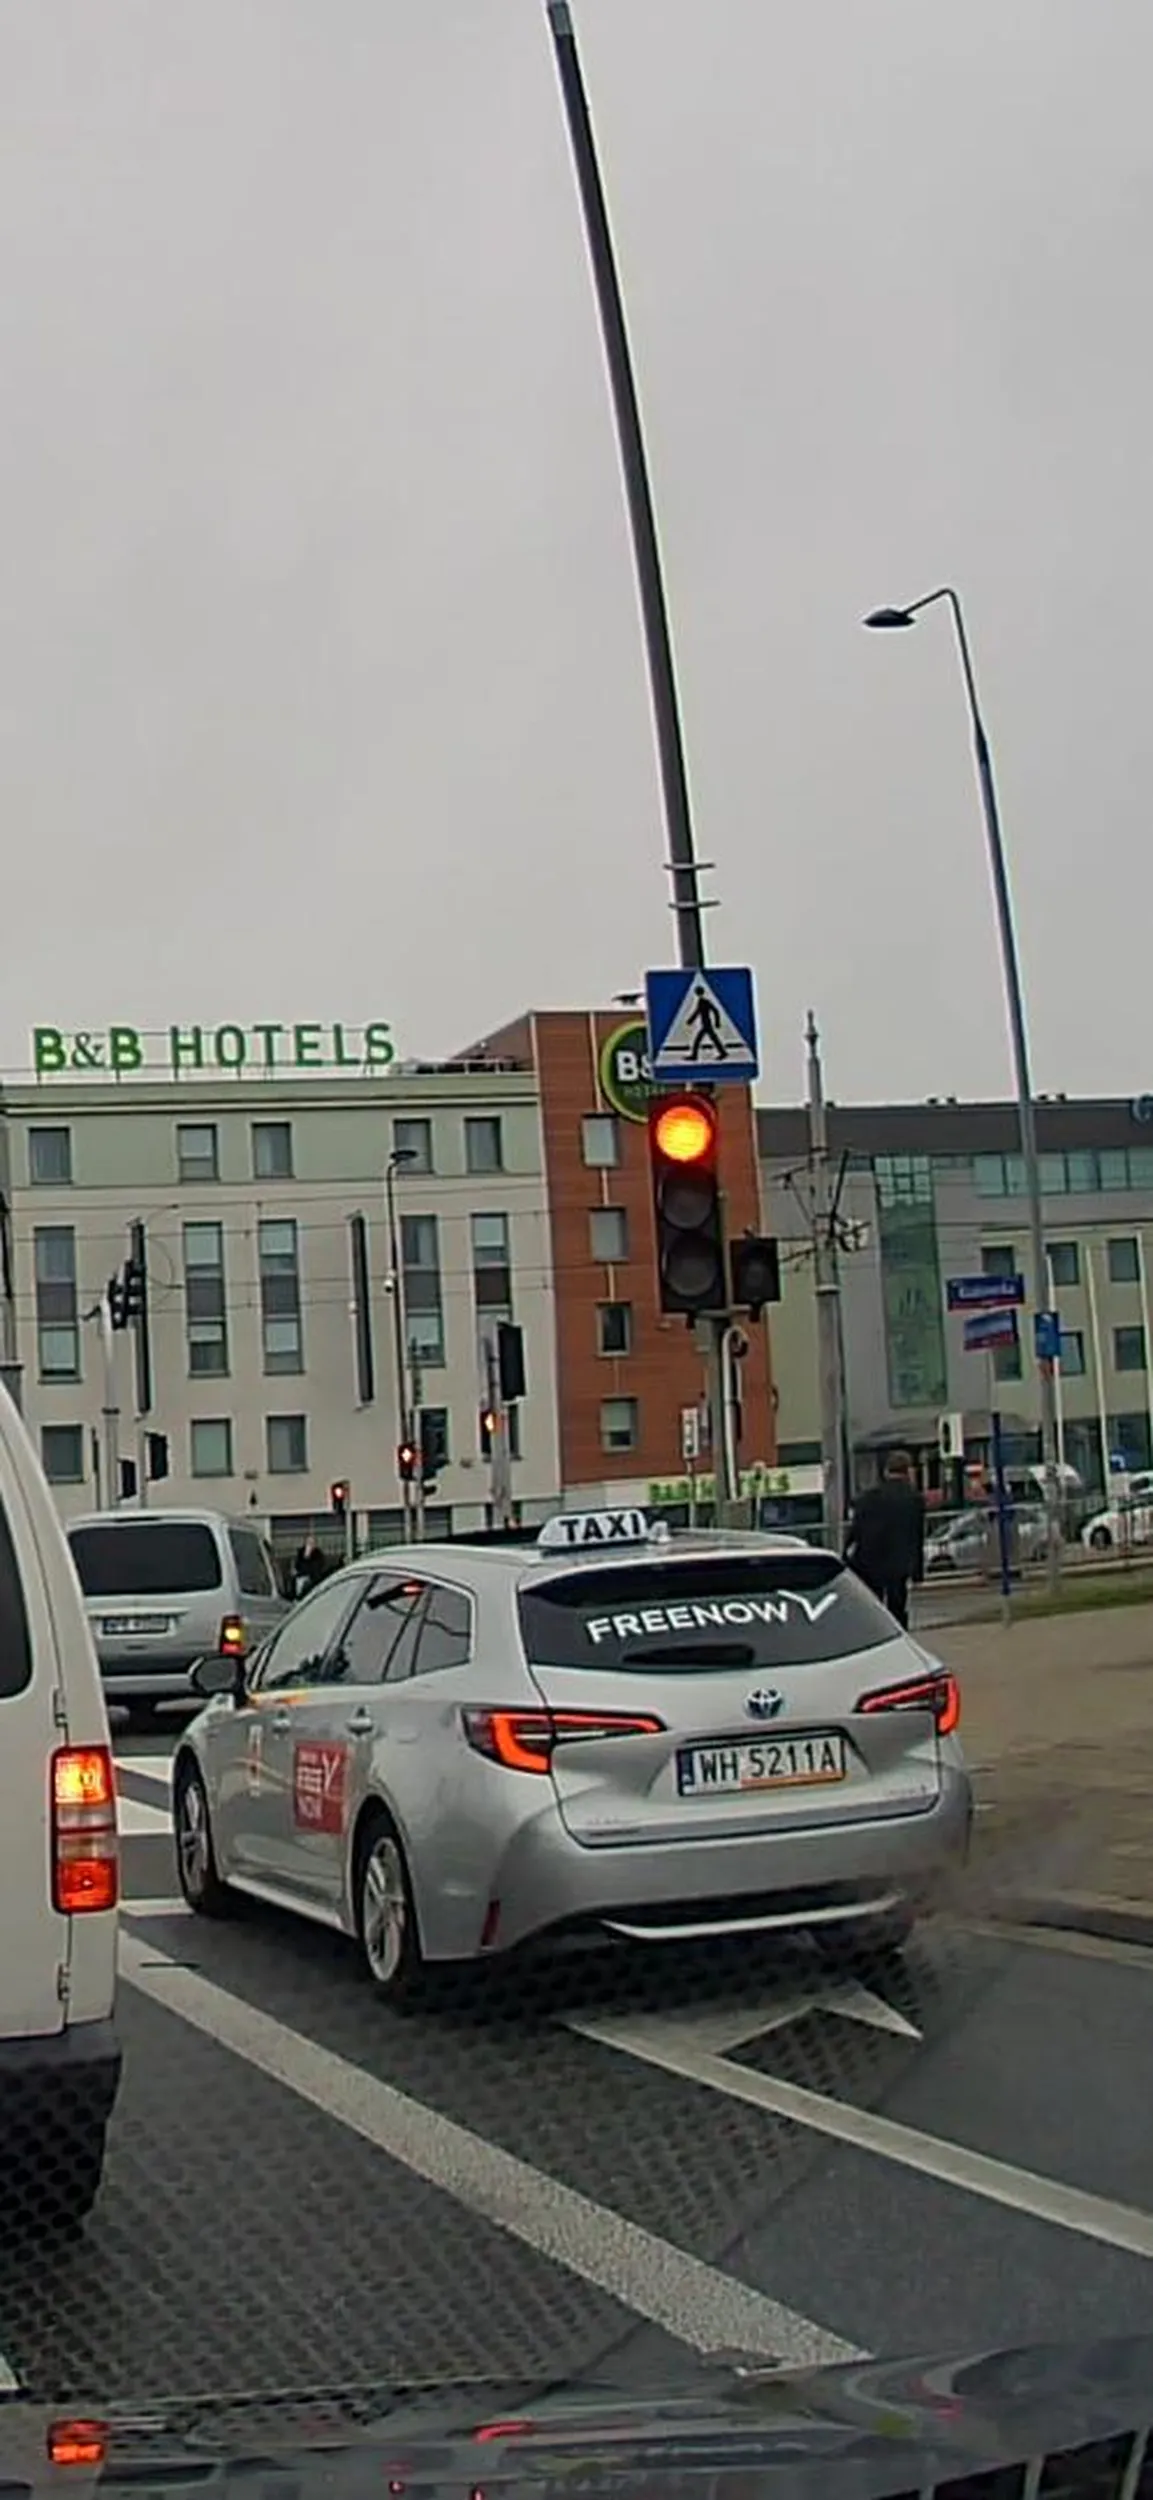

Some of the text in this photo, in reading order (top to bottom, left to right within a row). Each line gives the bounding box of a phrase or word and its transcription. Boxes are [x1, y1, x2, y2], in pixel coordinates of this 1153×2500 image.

[33, 1023, 396, 1071] B&B HOTELS
[560, 1512, 642, 1543] TAXI
[587, 1600, 789, 1644] FREENOW
[700, 1741, 837, 1782] WH 5211A
